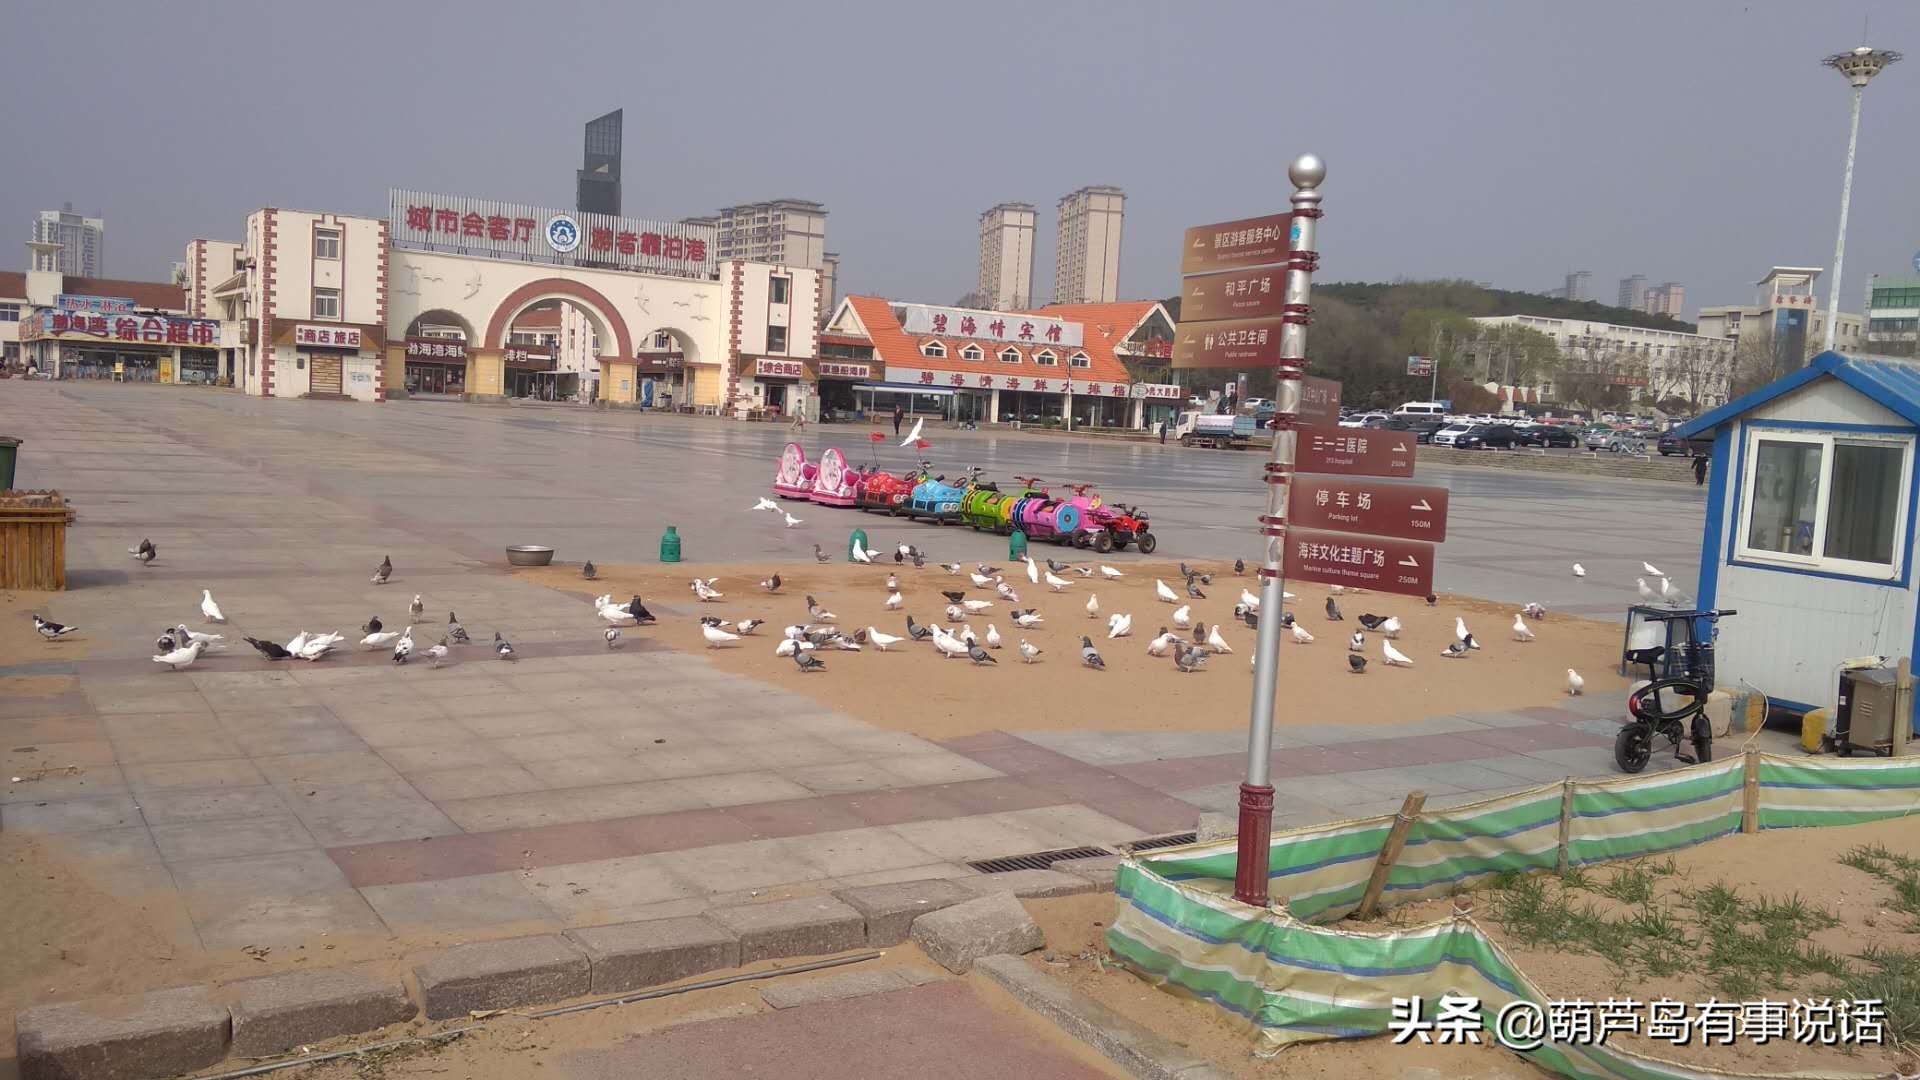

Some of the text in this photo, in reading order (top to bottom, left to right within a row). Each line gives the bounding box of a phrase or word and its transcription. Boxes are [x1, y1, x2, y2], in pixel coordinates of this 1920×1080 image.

[407, 204, 536, 242] 城市会客厅
[1214, 224, 1281, 248] 景区游客服务中心
[1225, 277, 1271, 297] 和平广场
[303, 328, 330, 344] 商店
[334, 331, 360, 346] 旅店
[931, 313, 1063, 342] 碧海情宾馆
[1217, 329, 1268, 347] 公共卫生间
[763, 360, 802, 376] 综合商店
[919, 371, 1126, 397] 碧海情海鲜大排档
[1312, 435, 1368, 454] 三一三医院
[1316, 489, 1371, 510] 停车场
[1328, 512, 1349, 522] Parking
[1411, 520, 1431, 529] 150M
[1298, 541, 1385, 567] 海洋文化主题广场
[1397, 575, 1418, 585] 250M
